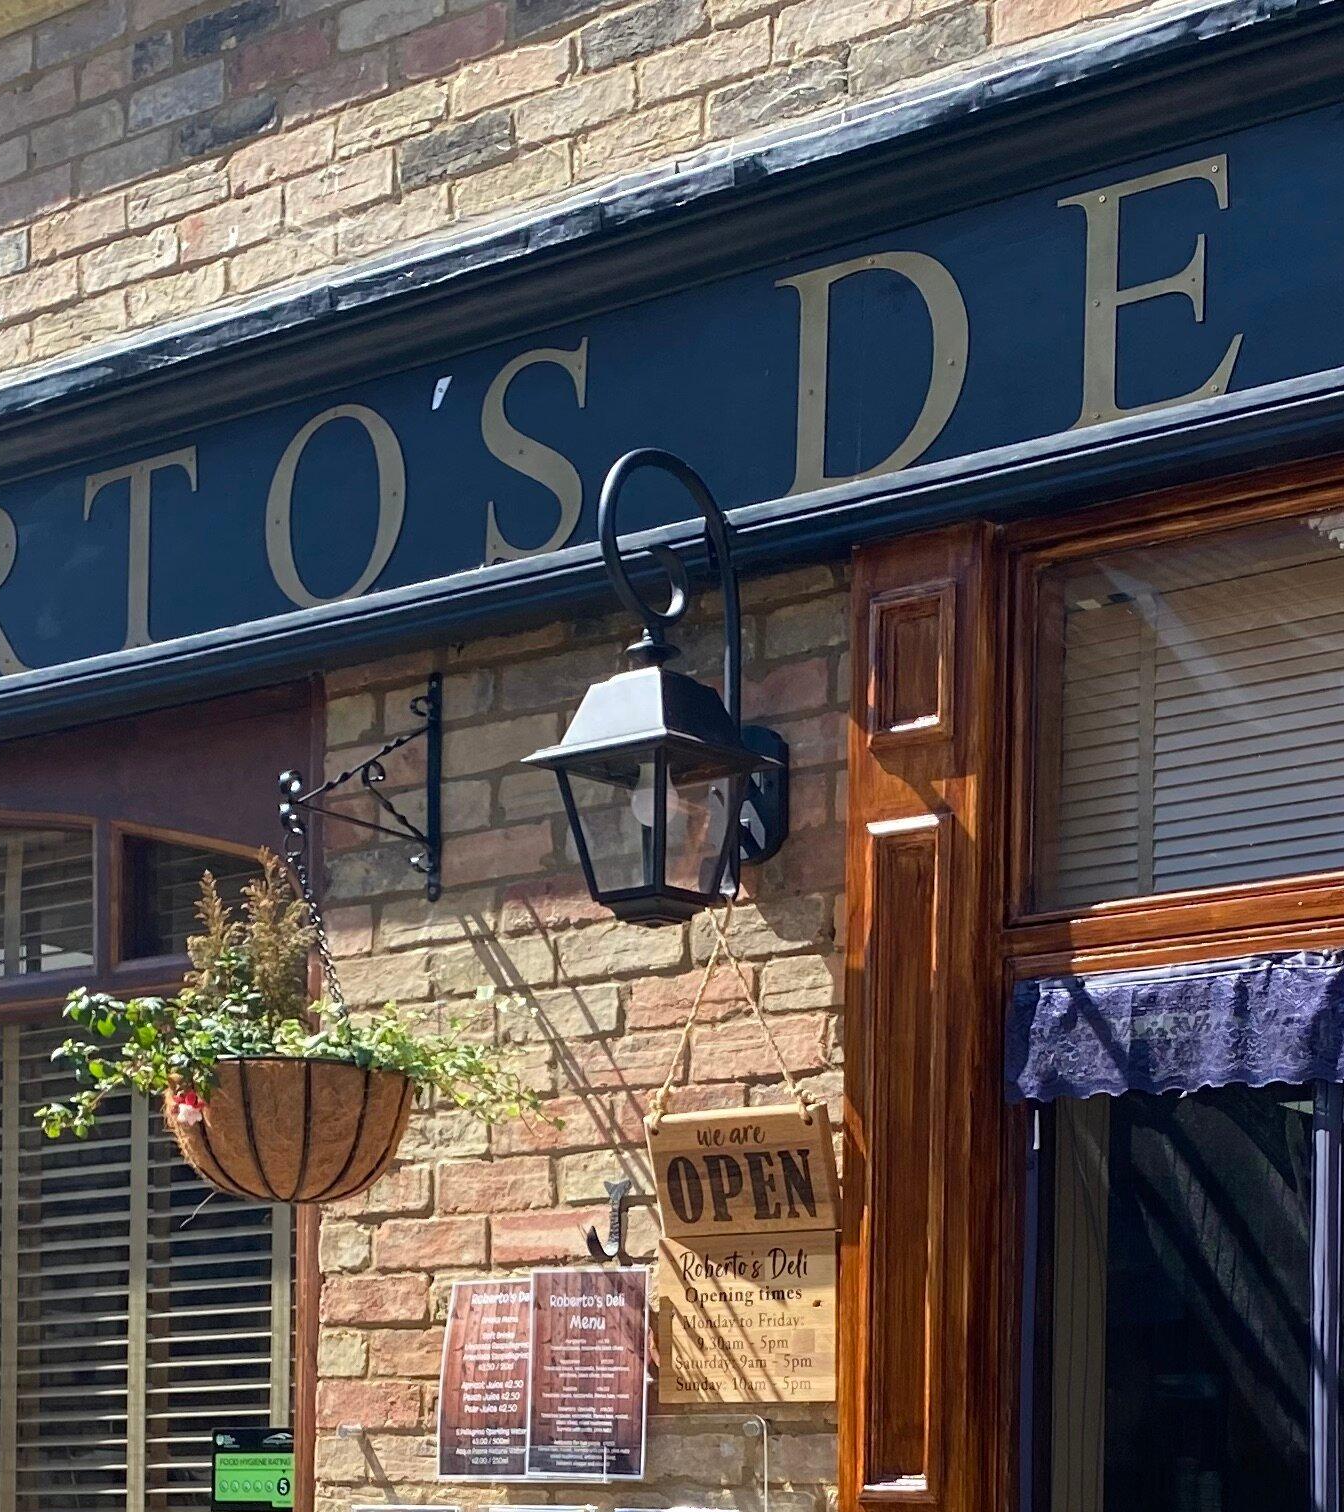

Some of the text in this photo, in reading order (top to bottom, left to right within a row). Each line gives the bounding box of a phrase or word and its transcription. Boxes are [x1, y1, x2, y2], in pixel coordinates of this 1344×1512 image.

[697, 1124, 766, 1147] we are
[667, 1149, 817, 1224] OPEN
[680, 1247, 808, 1281] Roberto's Deli
[550, 1292, 625, 1308] Roberto's Deli
[685, 1285, 803, 1308] Opening times
[569, 1314, 606, 1330] Menu
[683, 1313, 805, 1332] Monday to Friday:
[697, 1336, 745, 1350] 9.30am
[760, 1335, 789, 1352] 5pm
[739, 1355, 767, 1369] 9am
[783, 1354, 813, 1372] 5pm
[732, 1377, 767, 1391] 10am
[783, 1376, 812, 1394] 5pm
[220, 1457, 291, 1466] FOOD HYGIENE RATING
